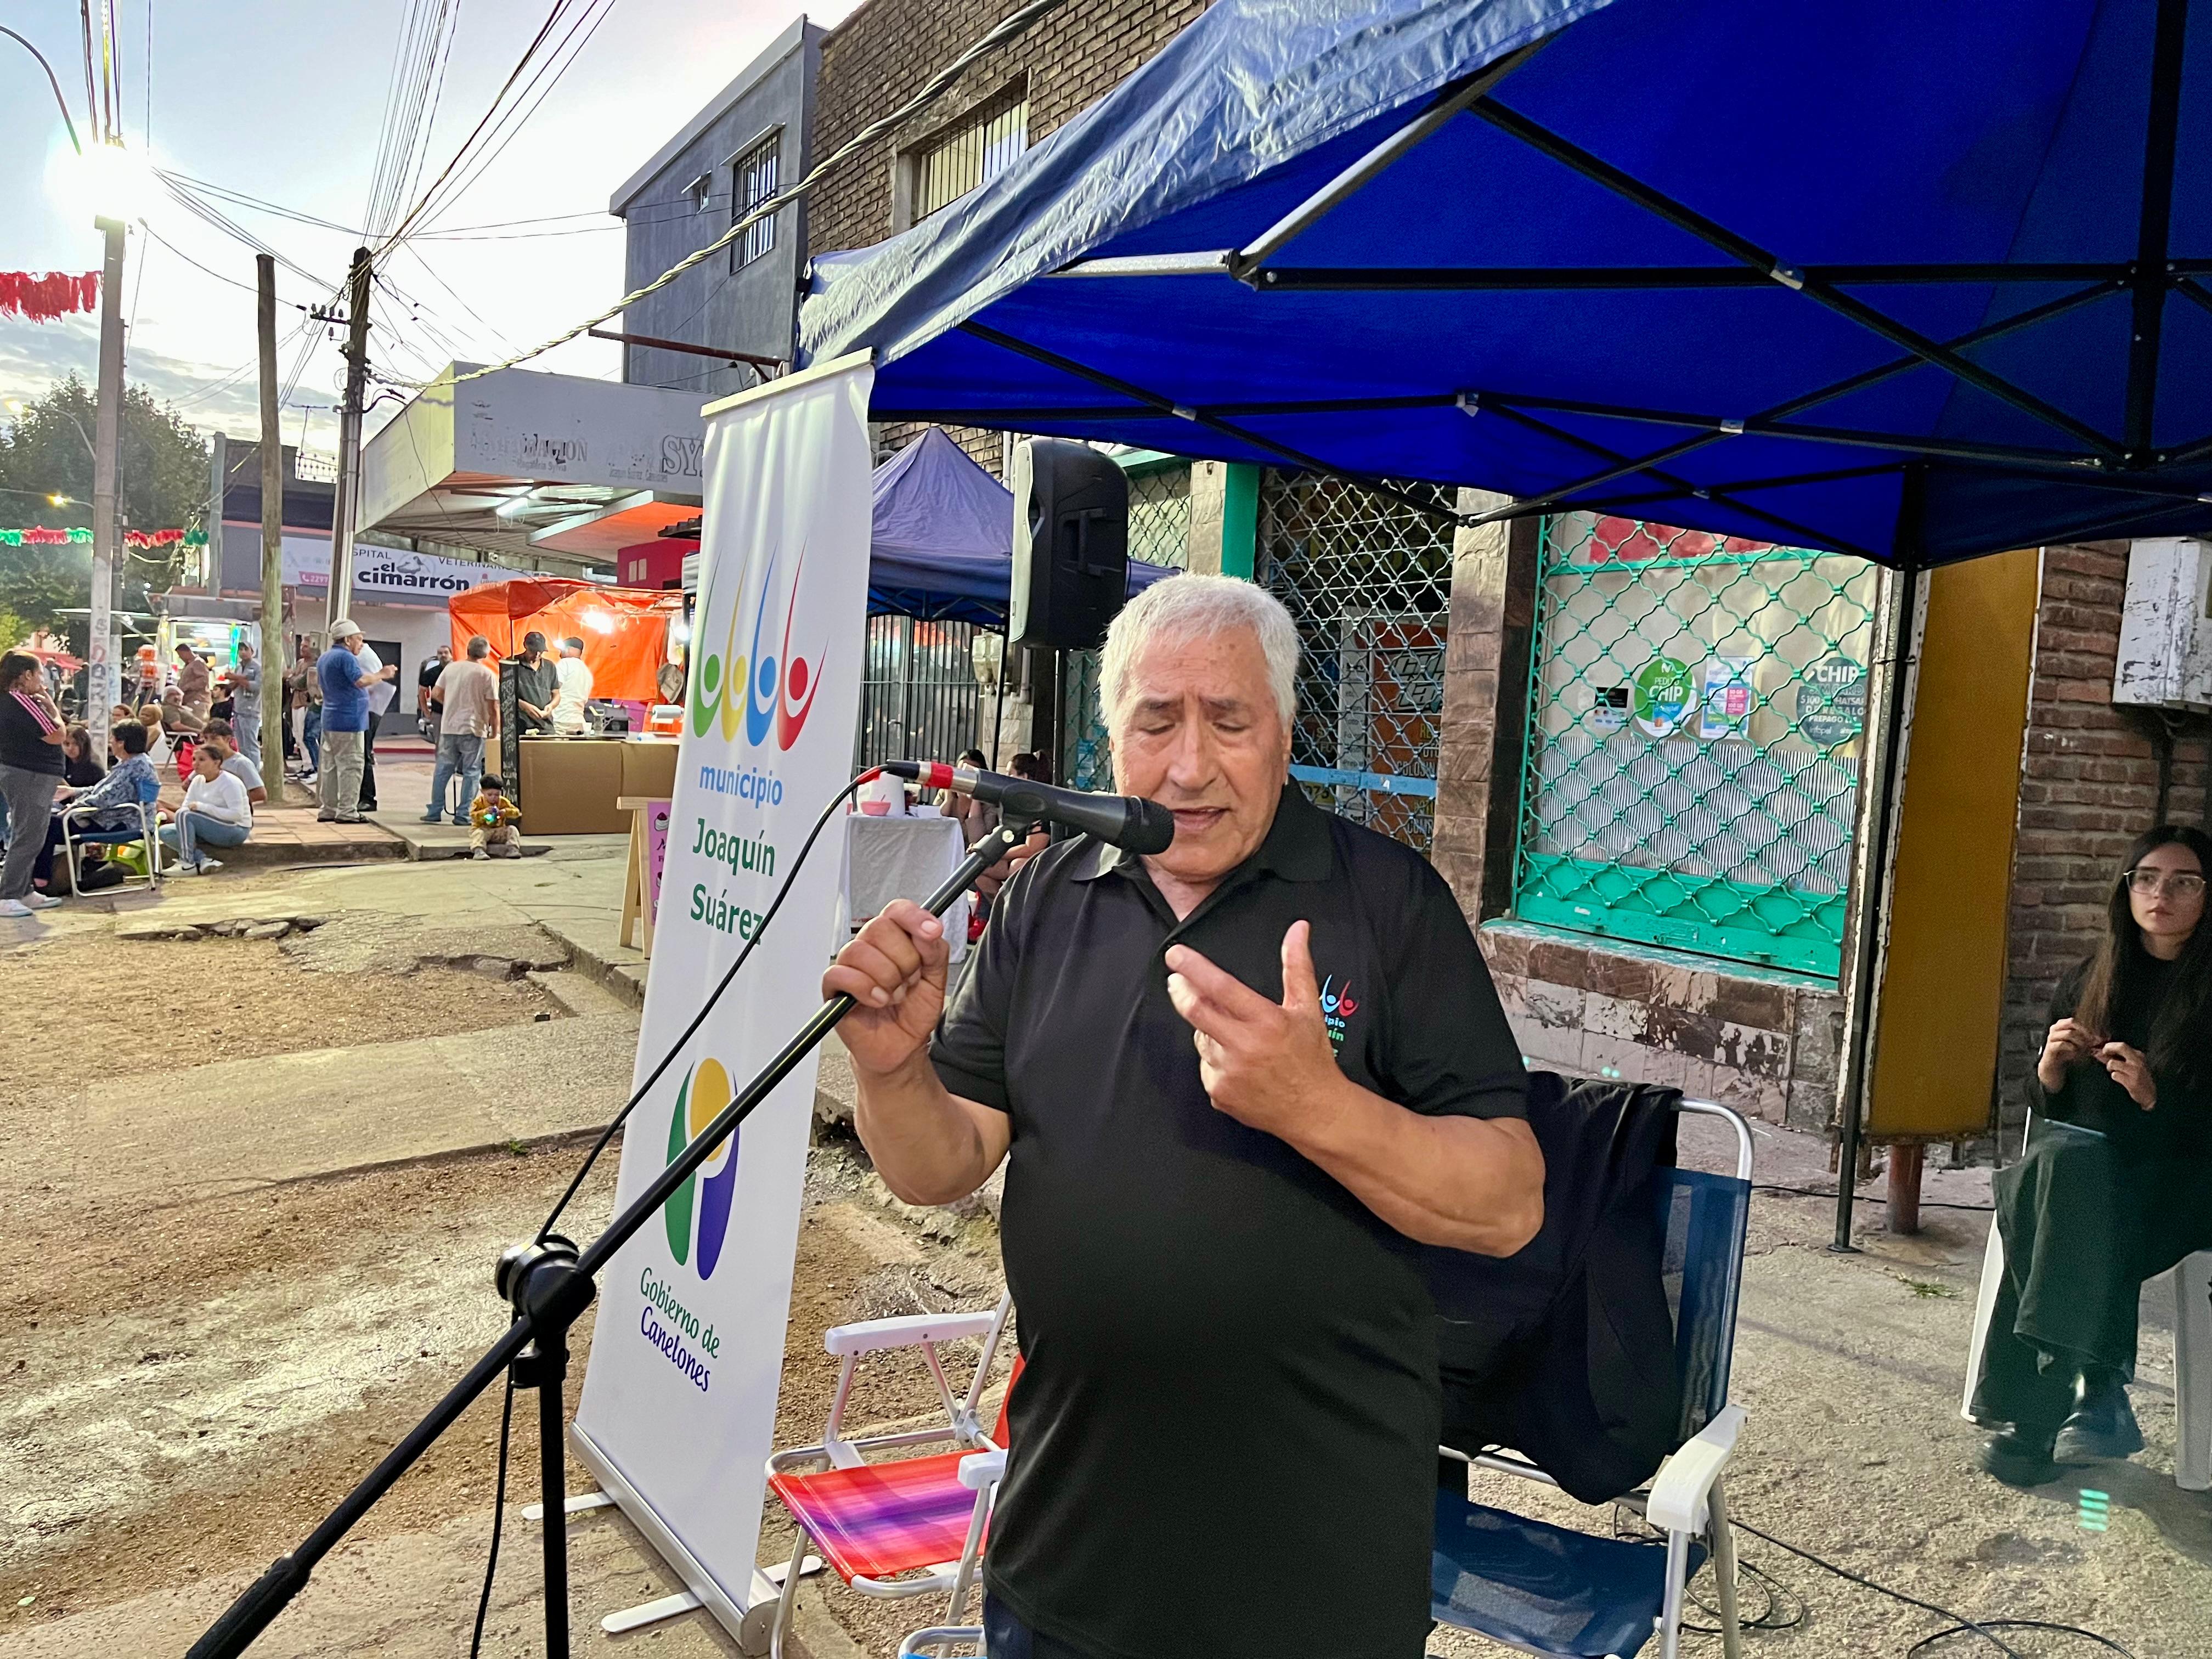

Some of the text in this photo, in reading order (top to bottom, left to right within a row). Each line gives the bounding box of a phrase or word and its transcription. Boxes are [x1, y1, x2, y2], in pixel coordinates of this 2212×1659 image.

[662, 435, 703, 477] SY
[358, 567, 470, 591] cimarrón
[380, 562, 395, 572] el
[1649, 685, 1683, 702] CHIP
[699, 764, 782, 809] municipio
[693, 817, 775, 877] Joaquín
[690, 883, 763, 945] Suárez
[641, 1267, 720, 1359] Gobierno de
[641, 1306, 710, 1392] Canelones
